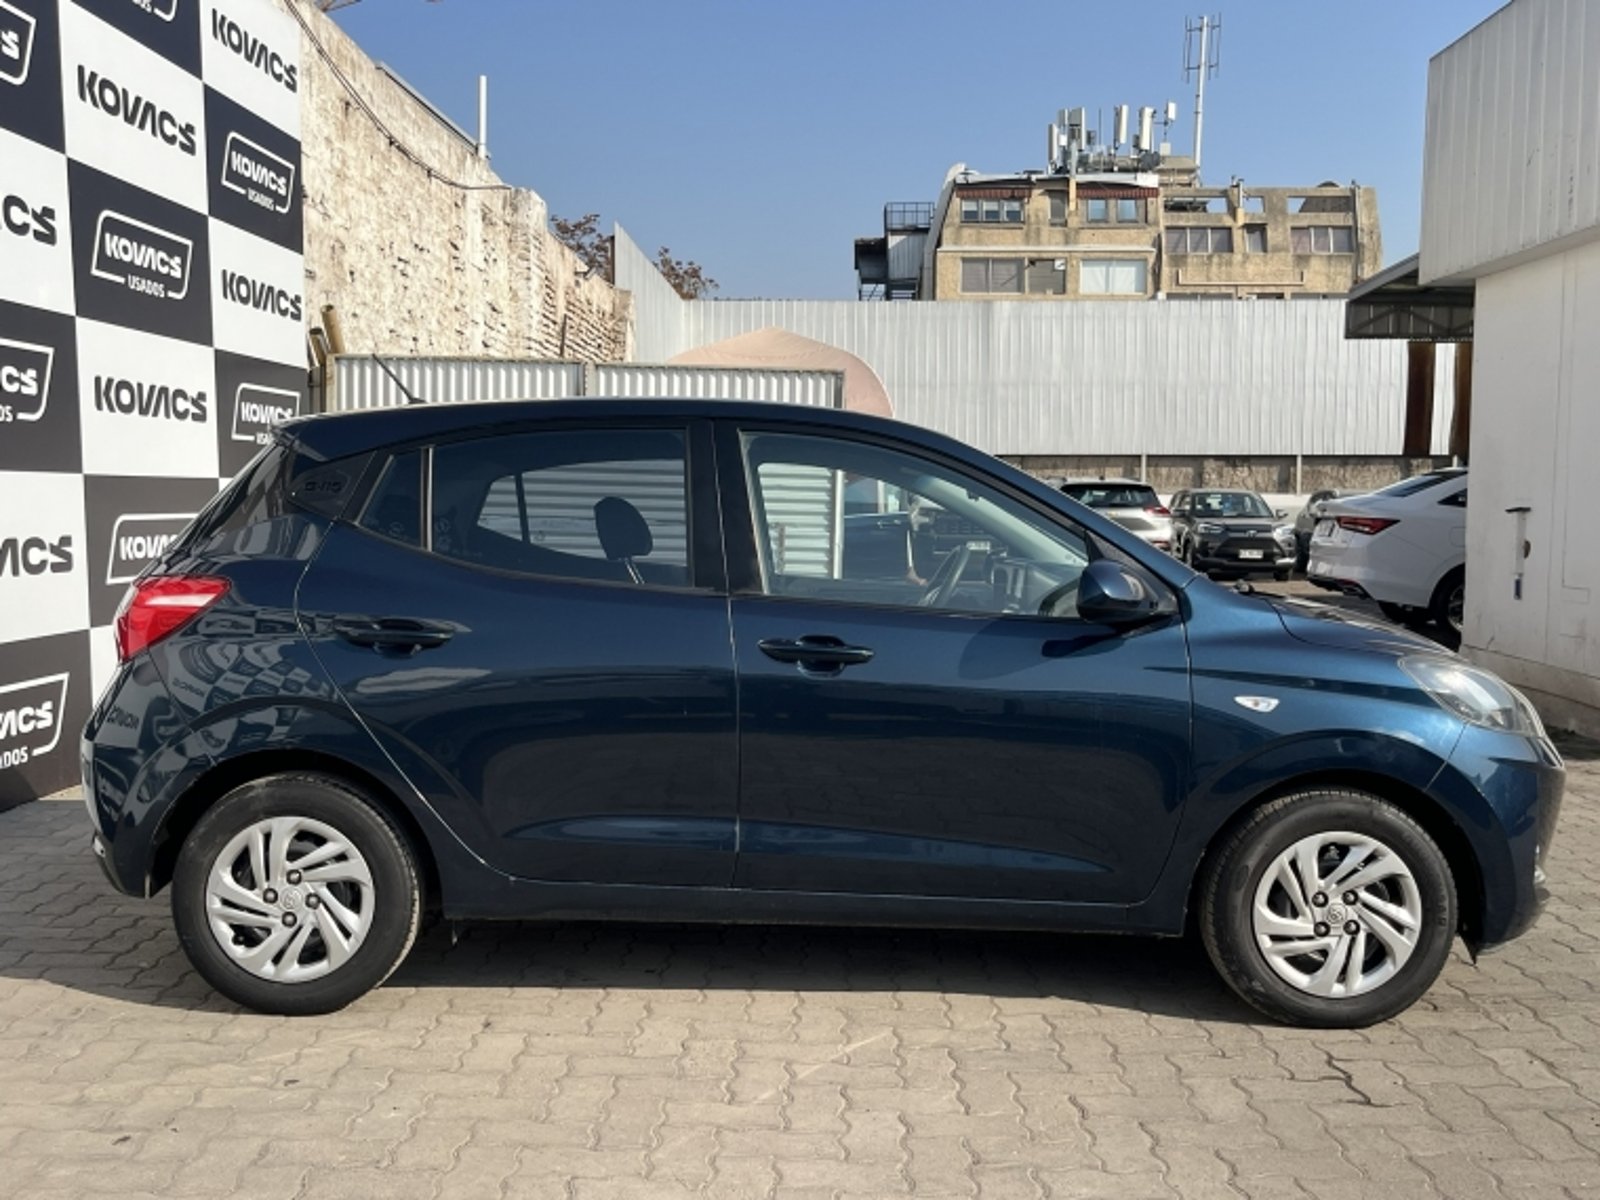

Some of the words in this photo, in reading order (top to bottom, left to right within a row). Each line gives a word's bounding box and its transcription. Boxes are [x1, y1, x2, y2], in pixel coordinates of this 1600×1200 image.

[211, 8, 297, 93] KOVACS
[77, 65, 196, 156] KOVACS
[231, 151, 286, 196] KOVACS
[105, 232, 181, 279] KOVACS
[128, 274, 165, 298] USADOS
[222, 269, 302, 322] KOVACS
[94, 375, 207, 423] KOVACS
